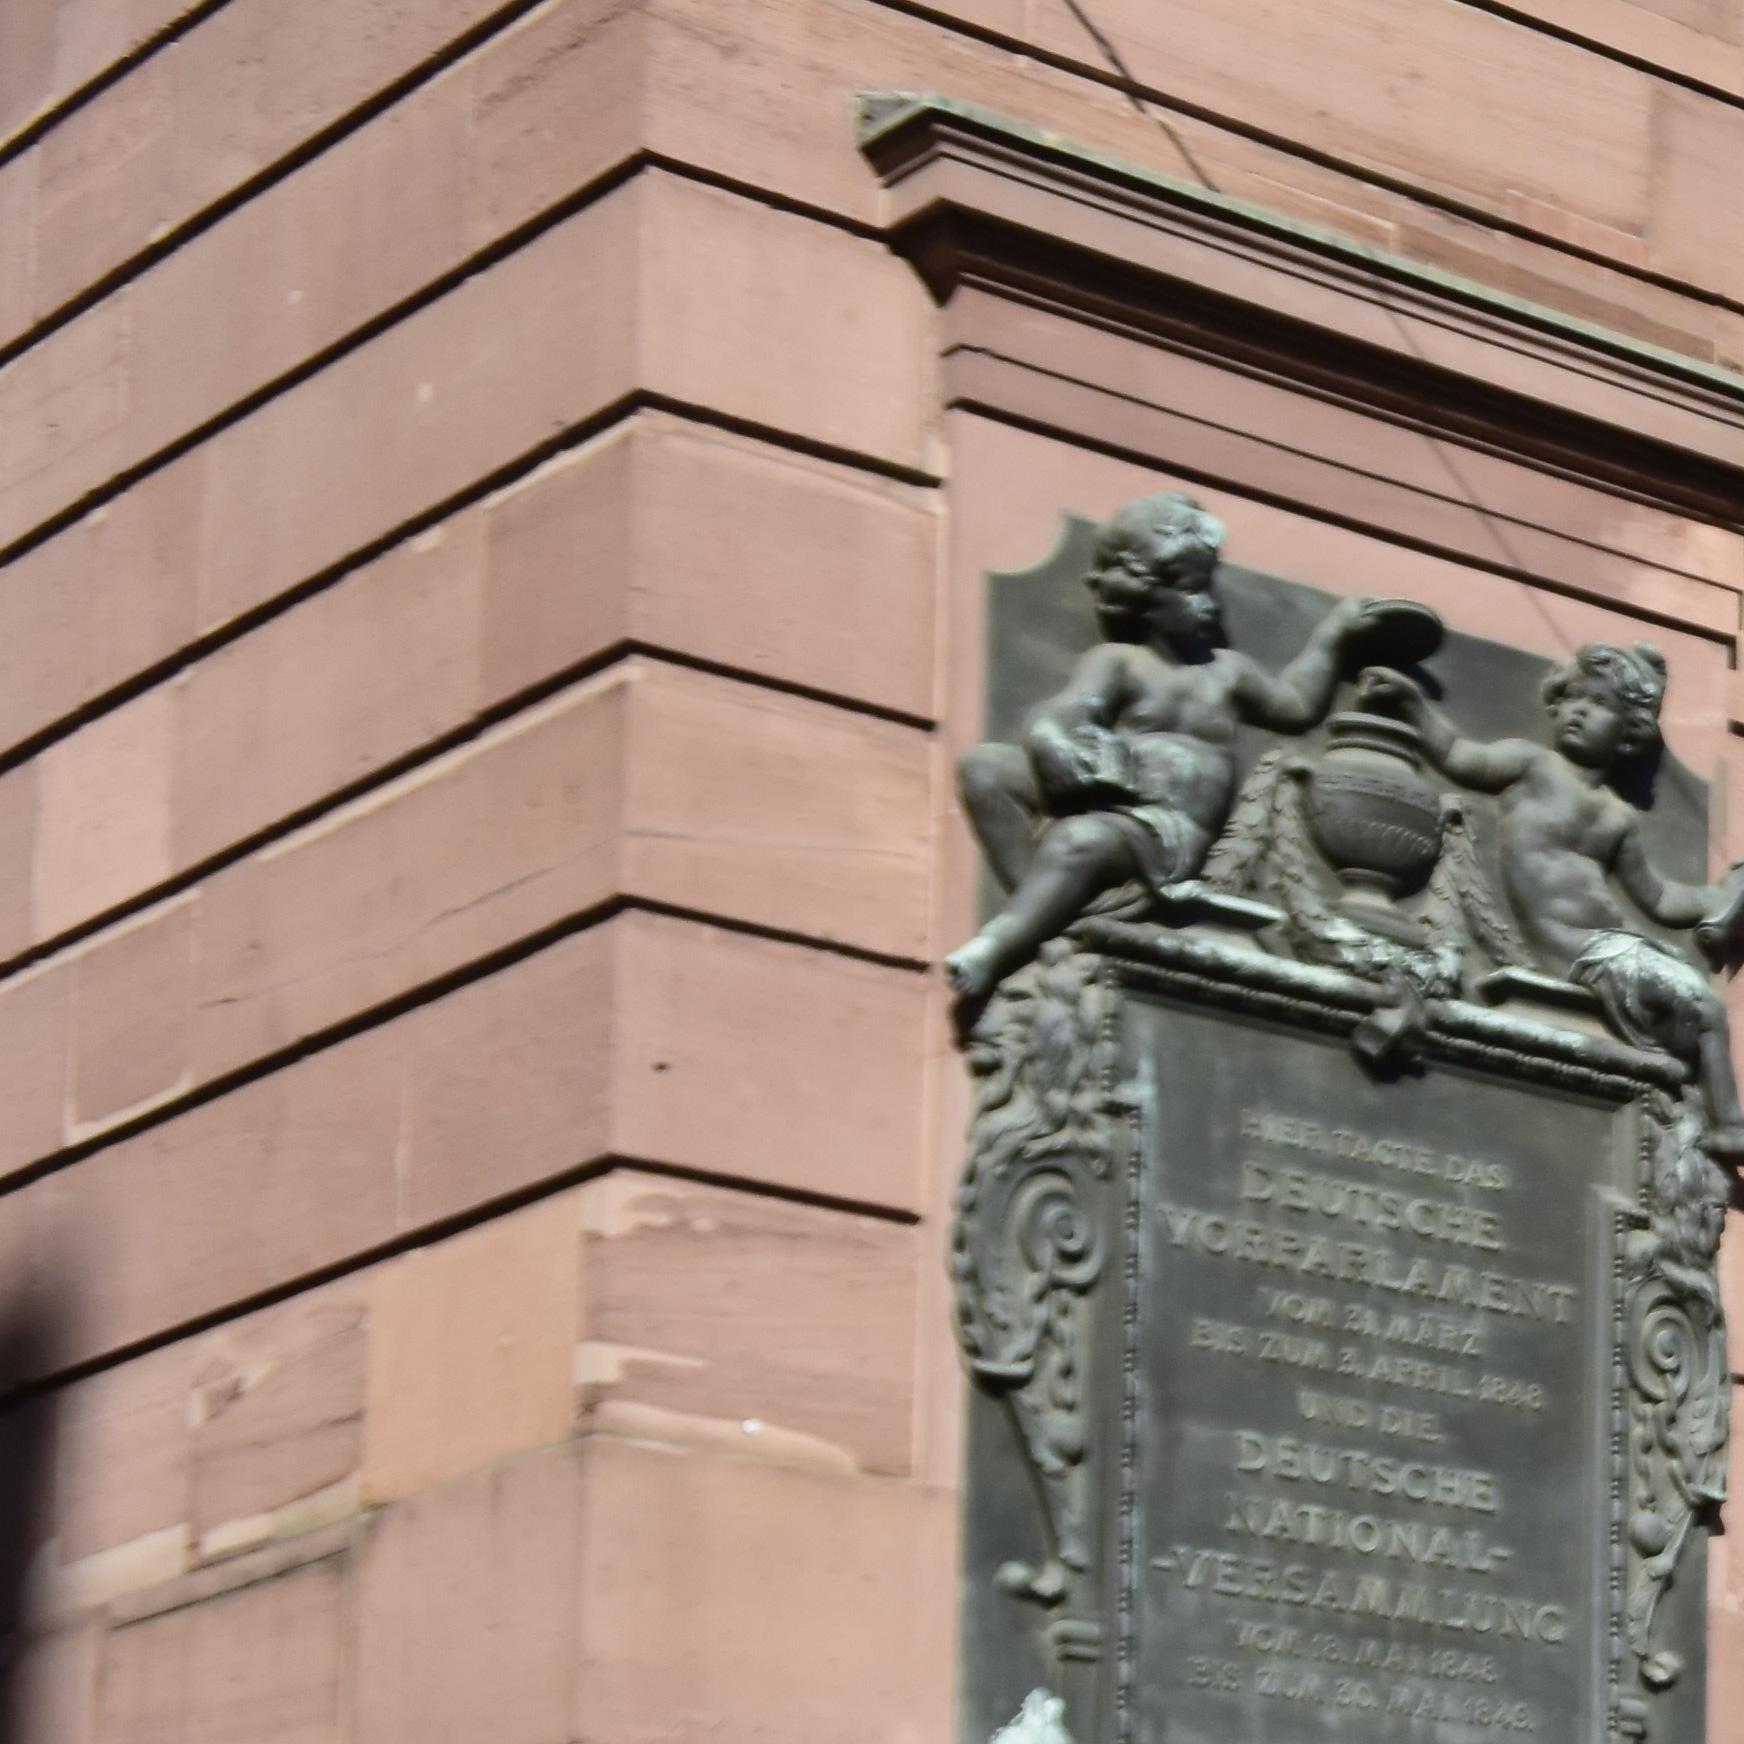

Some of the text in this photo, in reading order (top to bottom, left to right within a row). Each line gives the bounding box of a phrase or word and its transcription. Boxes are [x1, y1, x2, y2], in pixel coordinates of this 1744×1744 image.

[1242, 1158, 1504, 1252] DEUTSCHE
[1441, 1152, 1510, 1191] DAS
[1157, 1200, 1579, 1325] VORPARLAMENT
[1256, 1283, 1334, 1329] VOM
[1190, 1318, 1252, 1355] BIS
[1258, 1330, 1333, 1373] ZUM
[1366, 1356, 1474, 1400] APRIL
[1296, 1388, 1443, 1443] UND DIE
[1233, 1430, 1500, 1515] DEUTSCHE
[1223, 1490, 1516, 1575] NATIONAL-
[1227, 1618, 1302, 1658] VOM
[1353, 1636, 1424, 1675] MAI
[1186, 1655, 1243, 1691] BIS
[1255, 1666, 1326, 1706] ZUM
[1384, 1682, 1452, 1723] MAI
